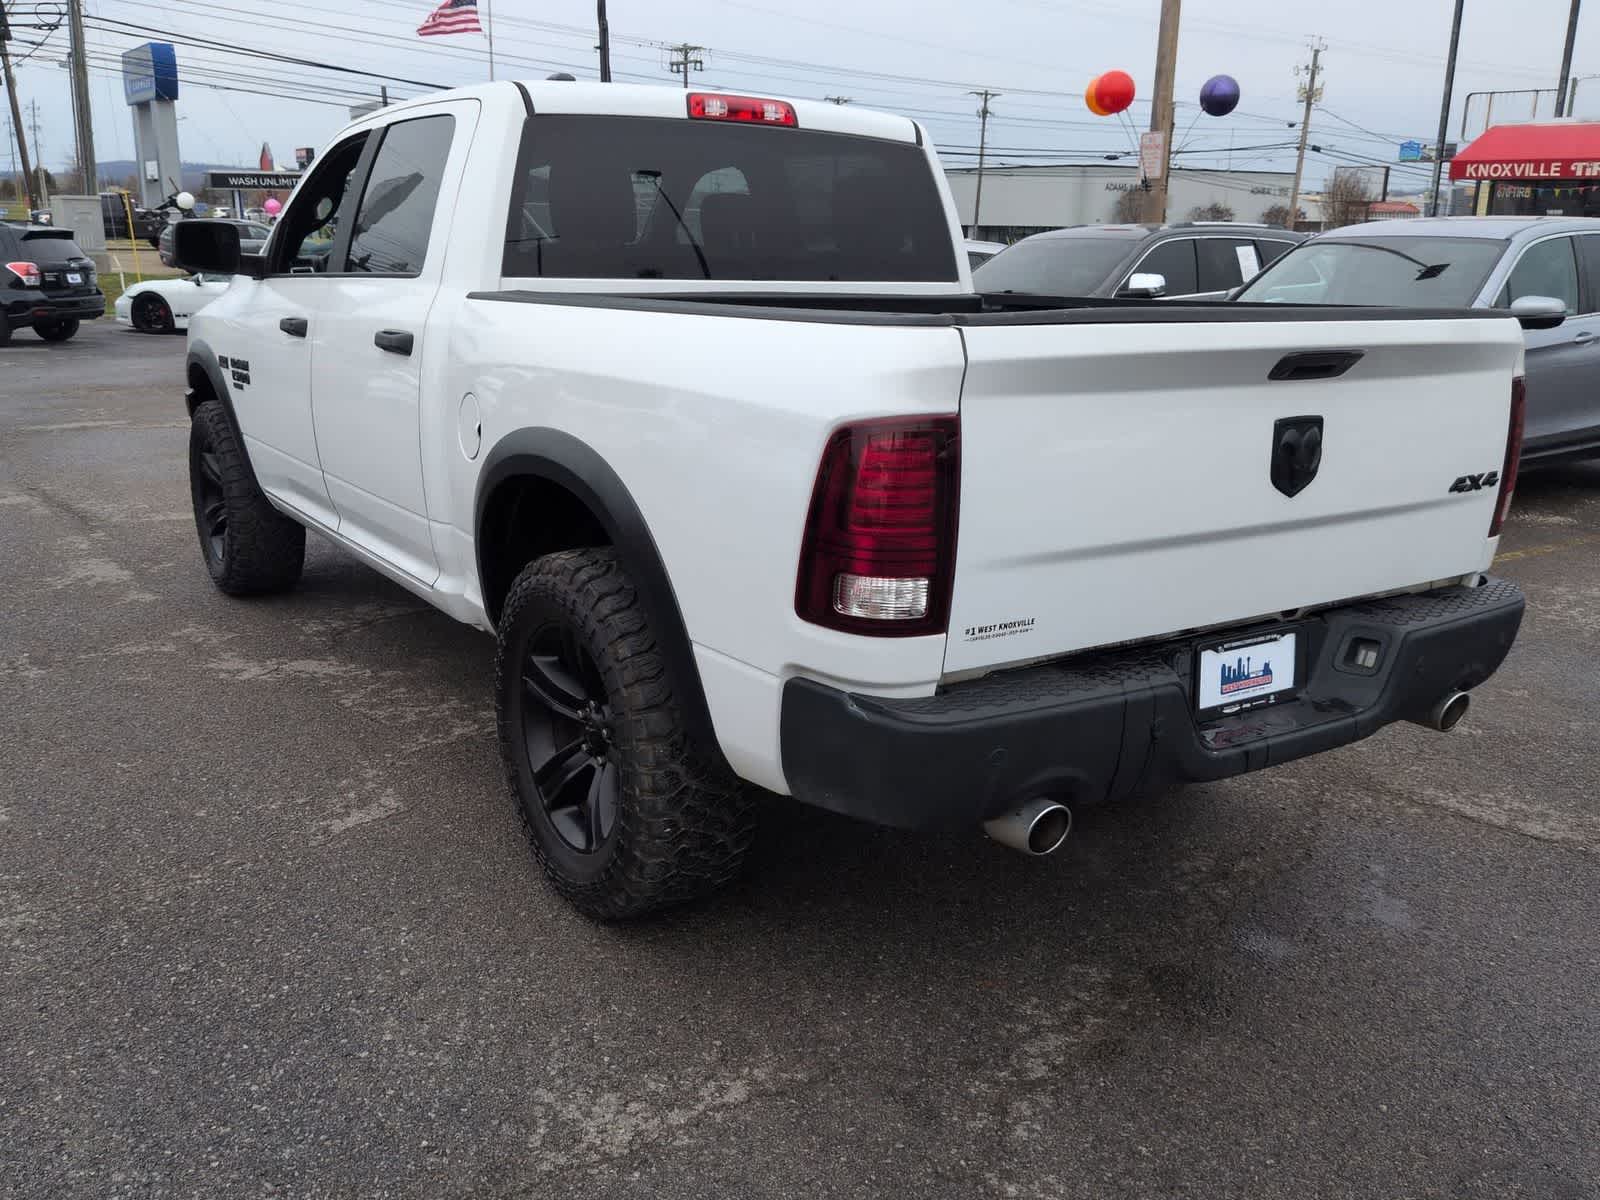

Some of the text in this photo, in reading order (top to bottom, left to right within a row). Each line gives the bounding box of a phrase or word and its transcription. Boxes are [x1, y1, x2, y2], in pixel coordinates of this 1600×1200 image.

[1465, 162, 1562, 177] KNOXVILLE
[228, 176, 258, 186] WASH
[977, 623, 998, 635] WEST
[998, 617, 1036, 631] KNOXVILLE
